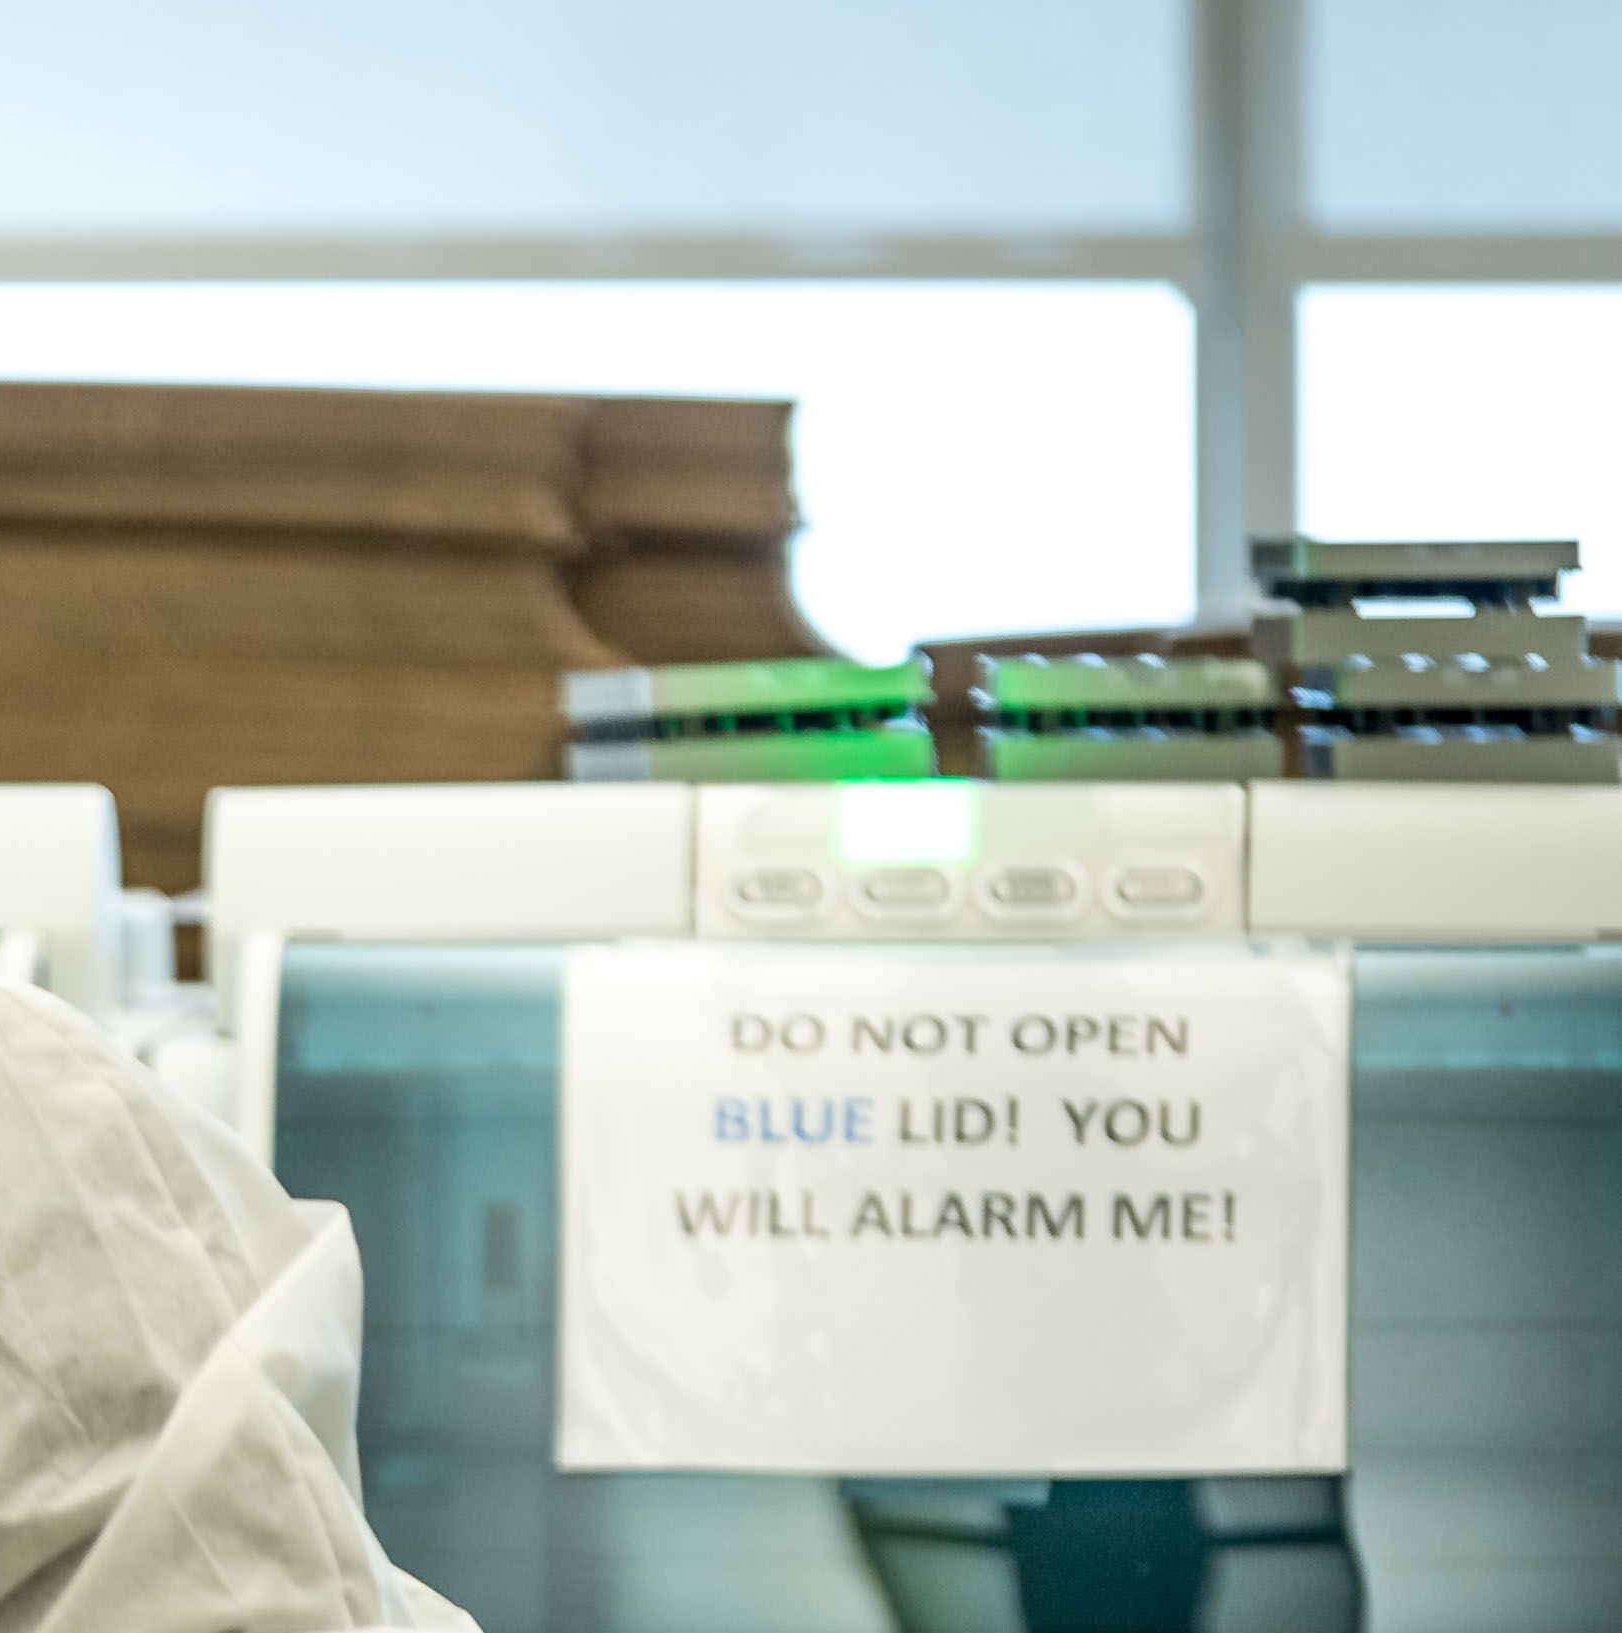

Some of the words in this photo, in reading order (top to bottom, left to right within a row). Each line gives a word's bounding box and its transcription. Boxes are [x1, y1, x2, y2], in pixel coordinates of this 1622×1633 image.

[731, 1012, 828, 1056] DO
[853, 1014, 990, 1057] NOT
[1011, 1014, 1191, 1057] OPEN
[713, 1097, 874, 1146] BLUE
[899, 1096, 1019, 1147] LID!
[1063, 1098, 1203, 1147] YOU
[675, 1188, 829, 1240] WILL
[851, 1190, 1087, 1241] ALARM
[1111, 1190, 1237, 1242] ME!
